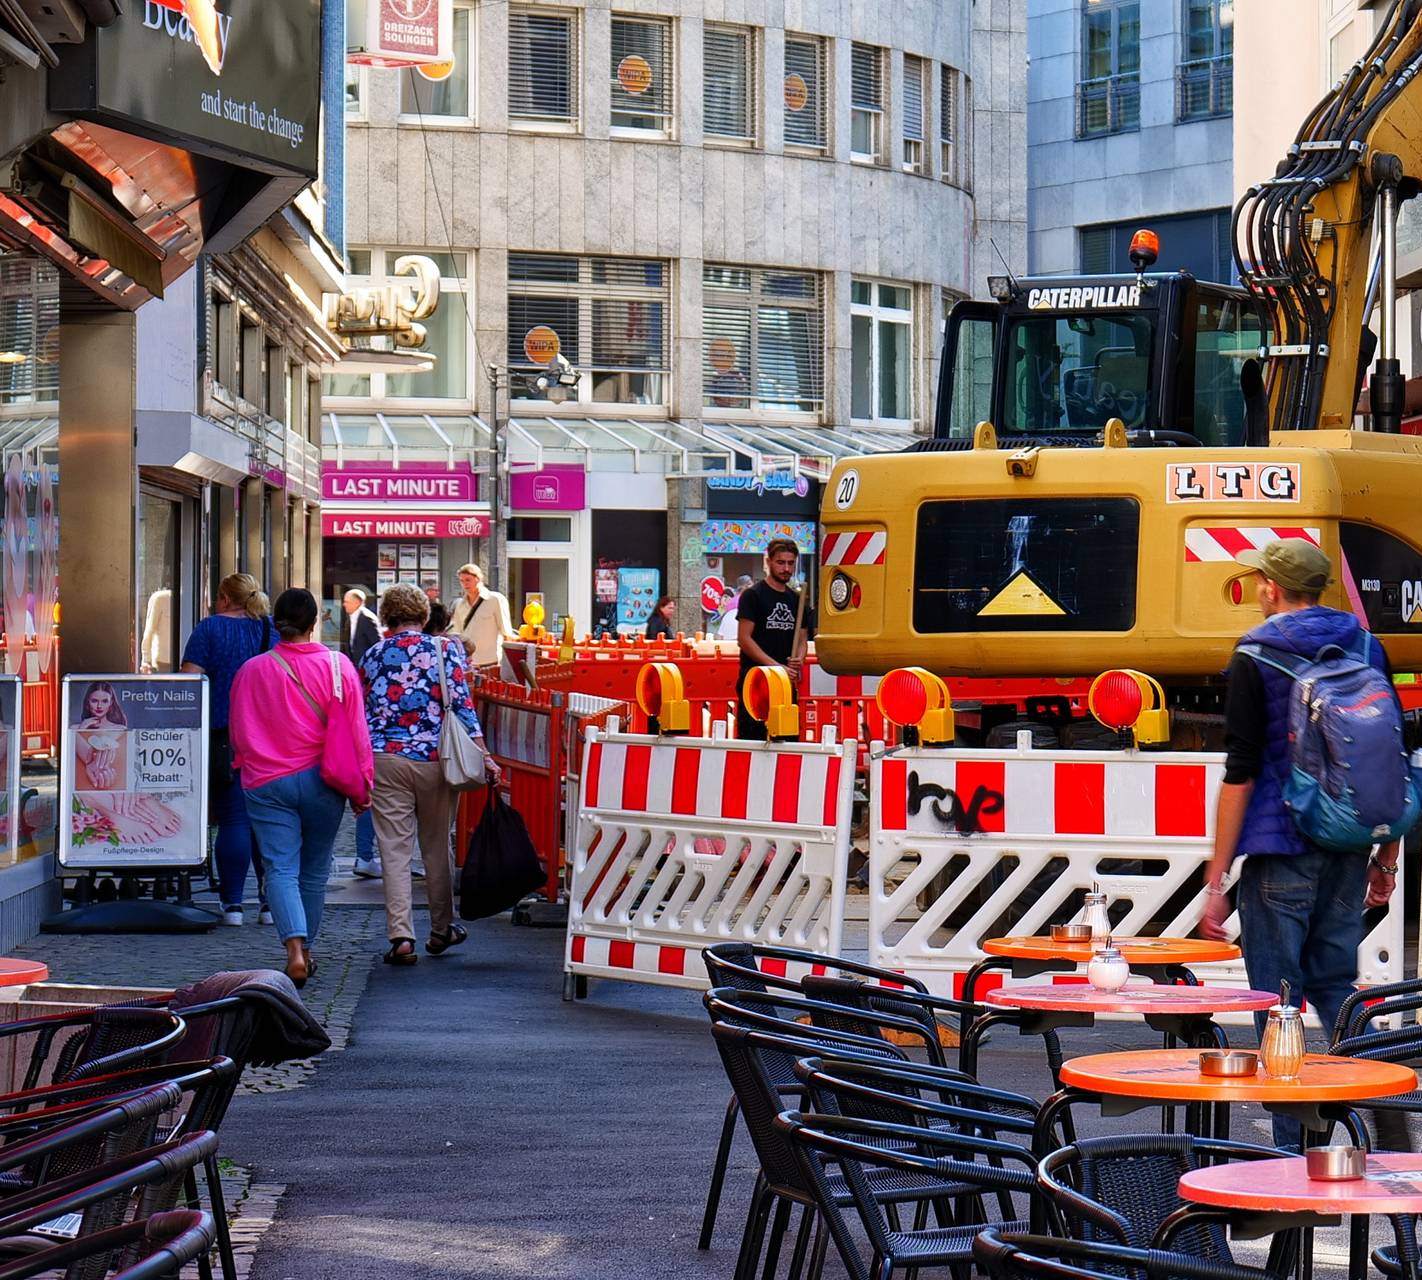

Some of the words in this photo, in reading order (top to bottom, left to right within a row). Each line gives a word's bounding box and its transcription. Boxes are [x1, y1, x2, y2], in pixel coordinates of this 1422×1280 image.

[143, 0, 232, 70] Beay
[384, 22, 434, 36] DREIZACK
[384, 33, 434, 46] SOLINGEN
[201, 89, 221, 117] and
[223, 99, 247, 125] start
[249, 101, 265, 131] the
[267, 108, 304, 148] change
[1027, 286, 1141, 309] CATERPILLAR
[332, 478, 382, 496] LAST
[386, 478, 460, 496] MINUTE
[838, 477, 855, 503] 20
[1175, 465, 1297, 499] LTG
[333, 520, 372, 535] LAST
[375, 520, 436, 535] MINUTE
[702, 583, 721, 605] 70%
[121, 690, 160, 703] Pretty
[163, 690, 196, 702] Nails
[141, 731, 185, 741] Schüler
[139, 748, 186, 766] 10%
[103, 847, 165, 855] Fußpflege-Design
